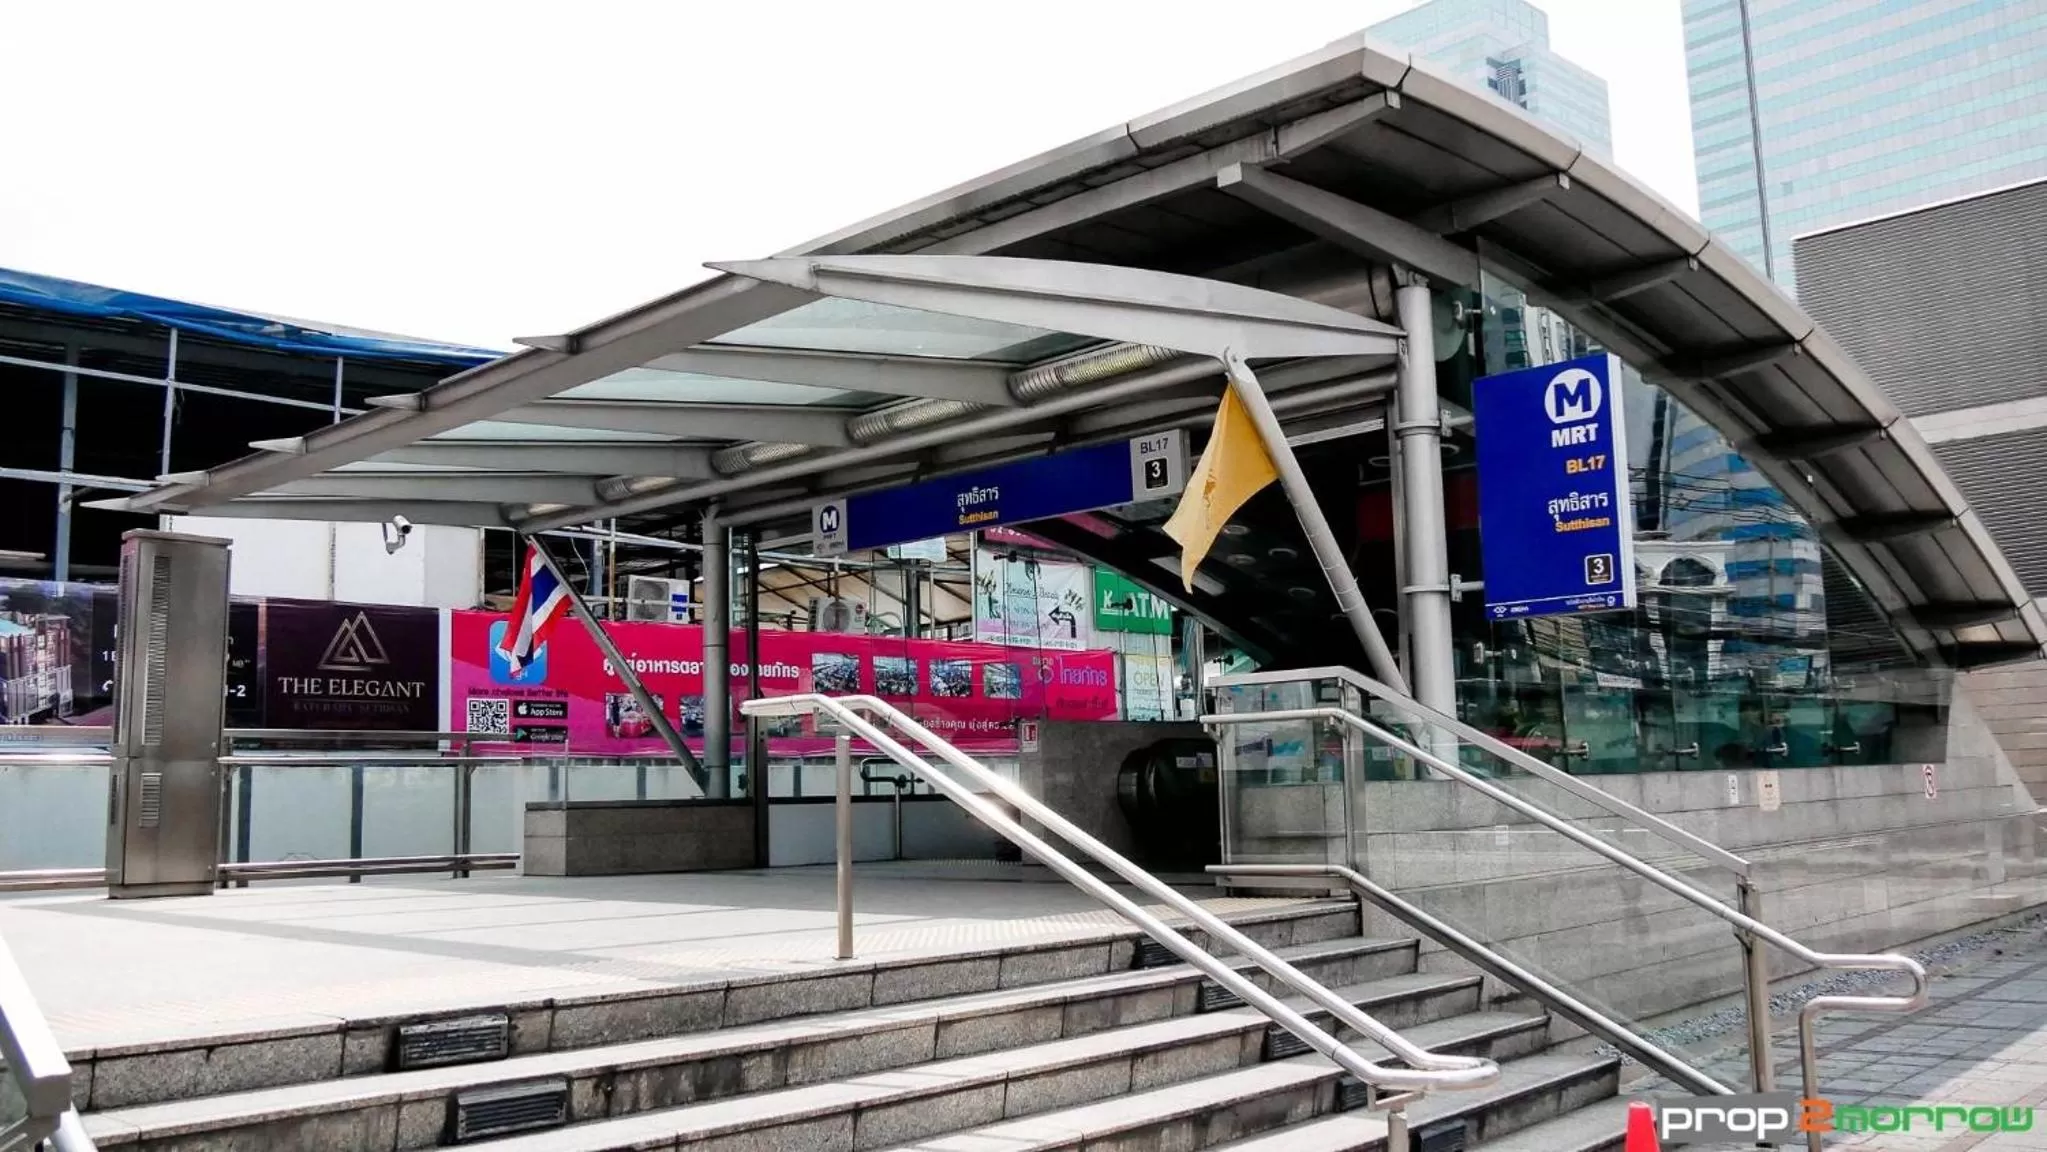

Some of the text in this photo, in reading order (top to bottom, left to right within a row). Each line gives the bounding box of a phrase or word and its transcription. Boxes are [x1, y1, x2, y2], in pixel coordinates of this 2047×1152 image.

[1551, 423, 1600, 448] MRT
[1140, 437, 1169, 454] BL17
[1151, 460, 1161, 478] 3
[1566, 455, 1606, 474] BL17
[957, 486, 999, 513] สุทธิสาร
[1547, 491, 1609, 522] สุทธิสาร
[958, 510, 999, 525] Sutthisan
[1555, 517, 1611, 532] Sutthisan
[1592, 557, 1605, 574] 3
[1123, 591, 1169, 619] ATM
[277, 676, 426, 698] THE ELEGANT
[530, 708, 564, 717] App Store
